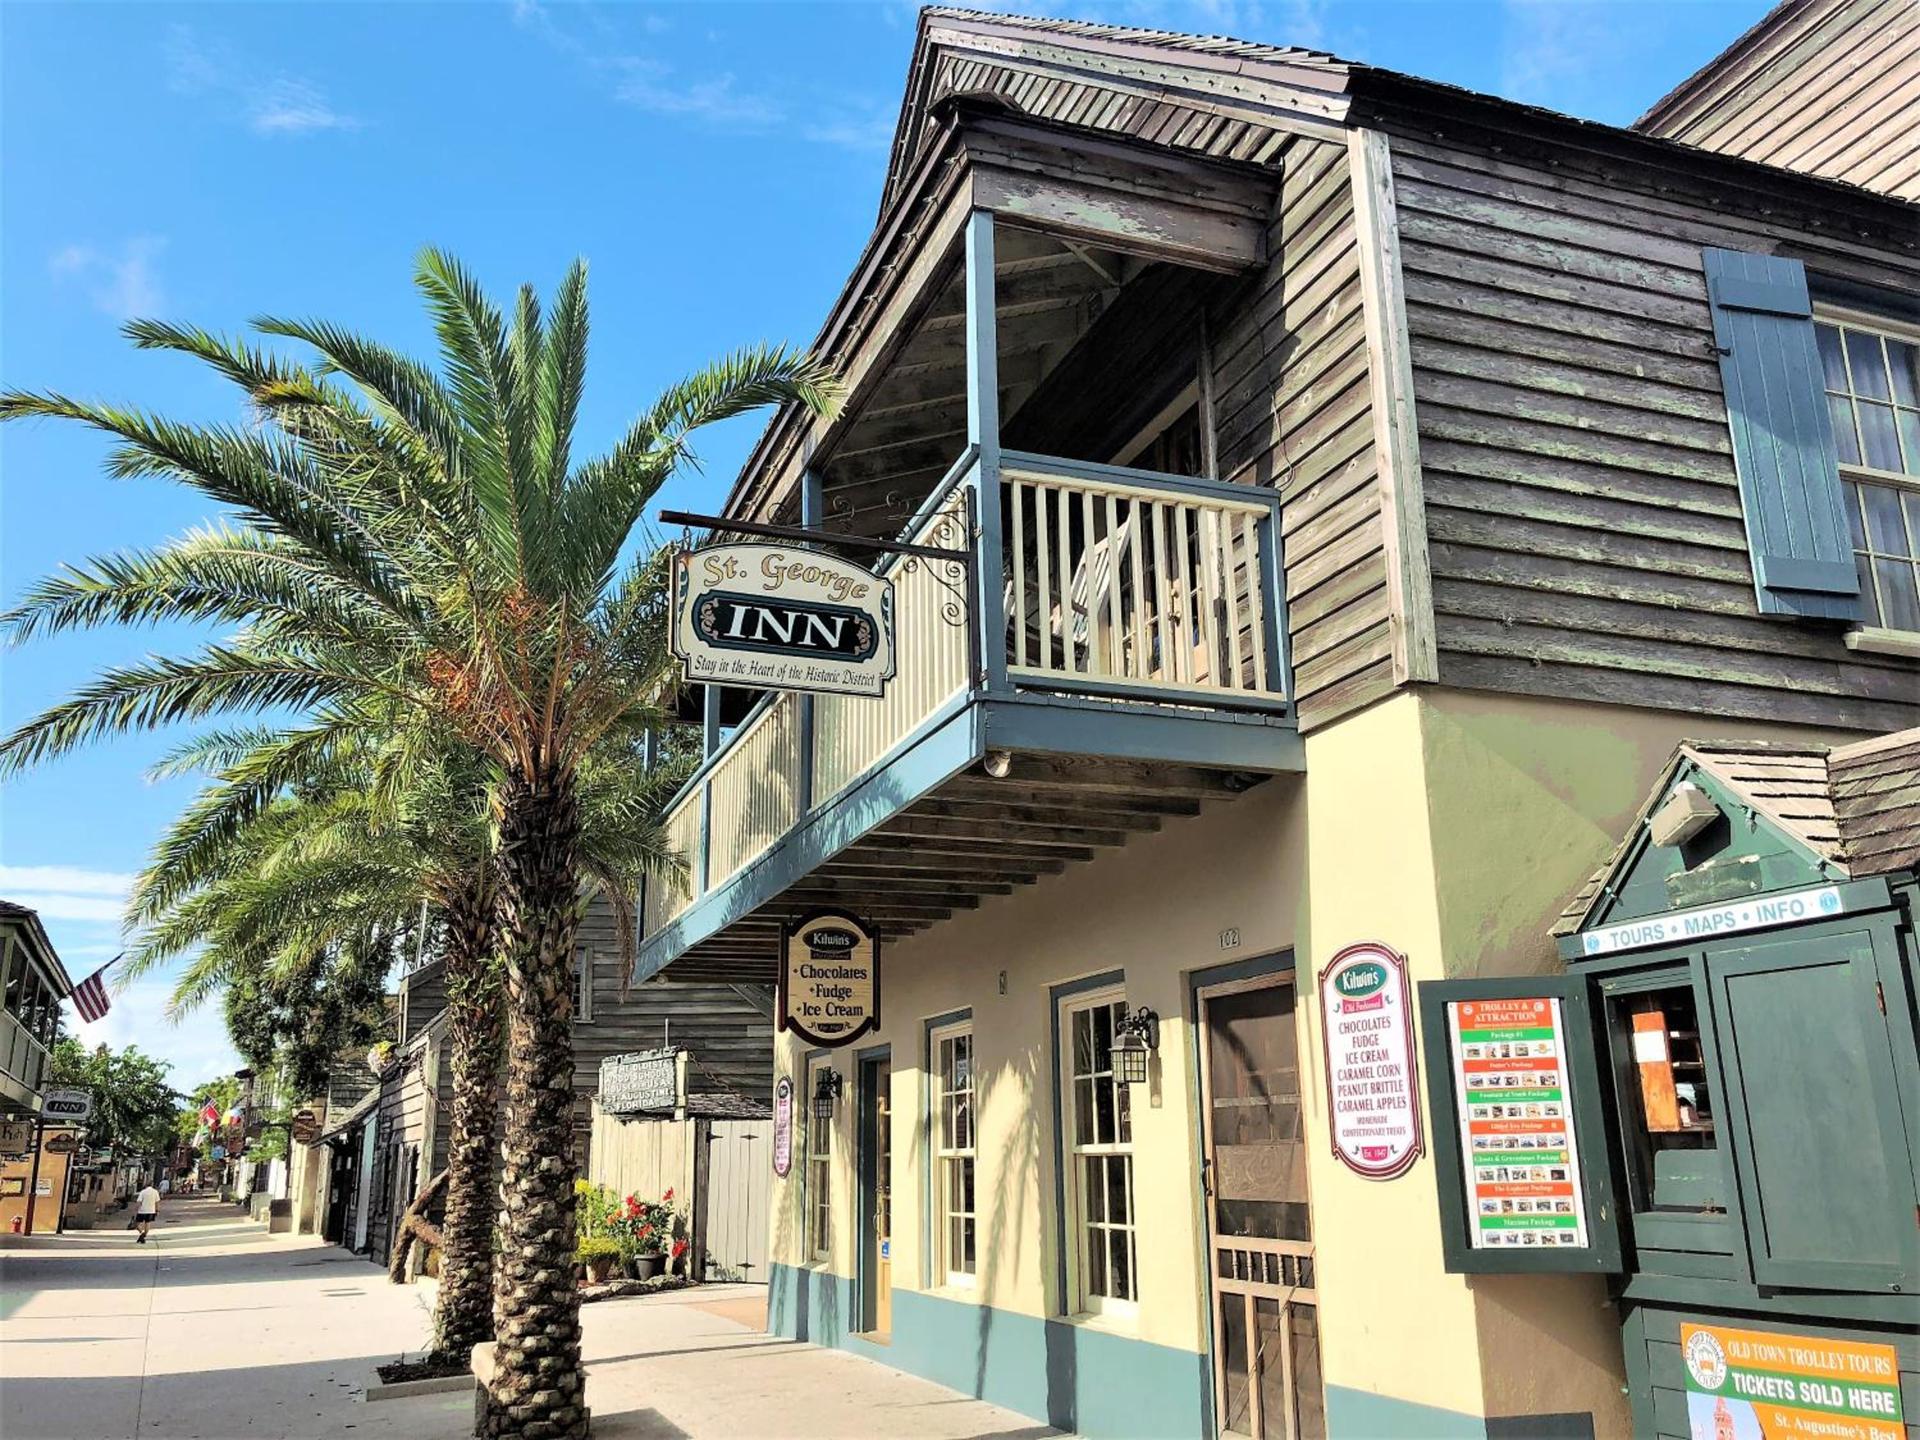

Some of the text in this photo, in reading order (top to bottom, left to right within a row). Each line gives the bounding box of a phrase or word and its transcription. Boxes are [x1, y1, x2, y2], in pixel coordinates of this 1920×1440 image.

[703, 553, 870, 602] St. George
[723, 602, 850, 650] INN
[694, 654, 875, 687] Stay in the Heart of the Historic District
[1609, 898, 1805, 948] TOURS MAPS INFO
[800, 963, 868, 979] Chocolates
[815, 982, 852, 1002] Fudge
[802, 1001, 864, 1017] Ice Cream
[1474, 1011, 1537, 1023] ATTRACTION
[1338, 1015, 1391, 1035] CHOCOLATES
[1352, 1033, 1380, 1049] FUDGE
[1345, 1048, 1390, 1065] ICE CREAM
[1337, 1063, 1401, 1081] CARAMEL CORN
[1337, 1079, 1404, 1097] PEANUT BRITTLE
[1337, 1095, 1407, 1112] CARAMEL APPLES
[1727, 1340, 1751, 1359] OLD
[1751, 1344, 1786, 1363] TOWN
[1788, 1348, 1846, 1372] TROLLEY
[1847, 1355, 1892, 1376] TOURS
[1731, 1372, 1896, 1414] TICKETS SOLD HERE
[1774, 1411, 1897, 1440] St. Augustine's Best
